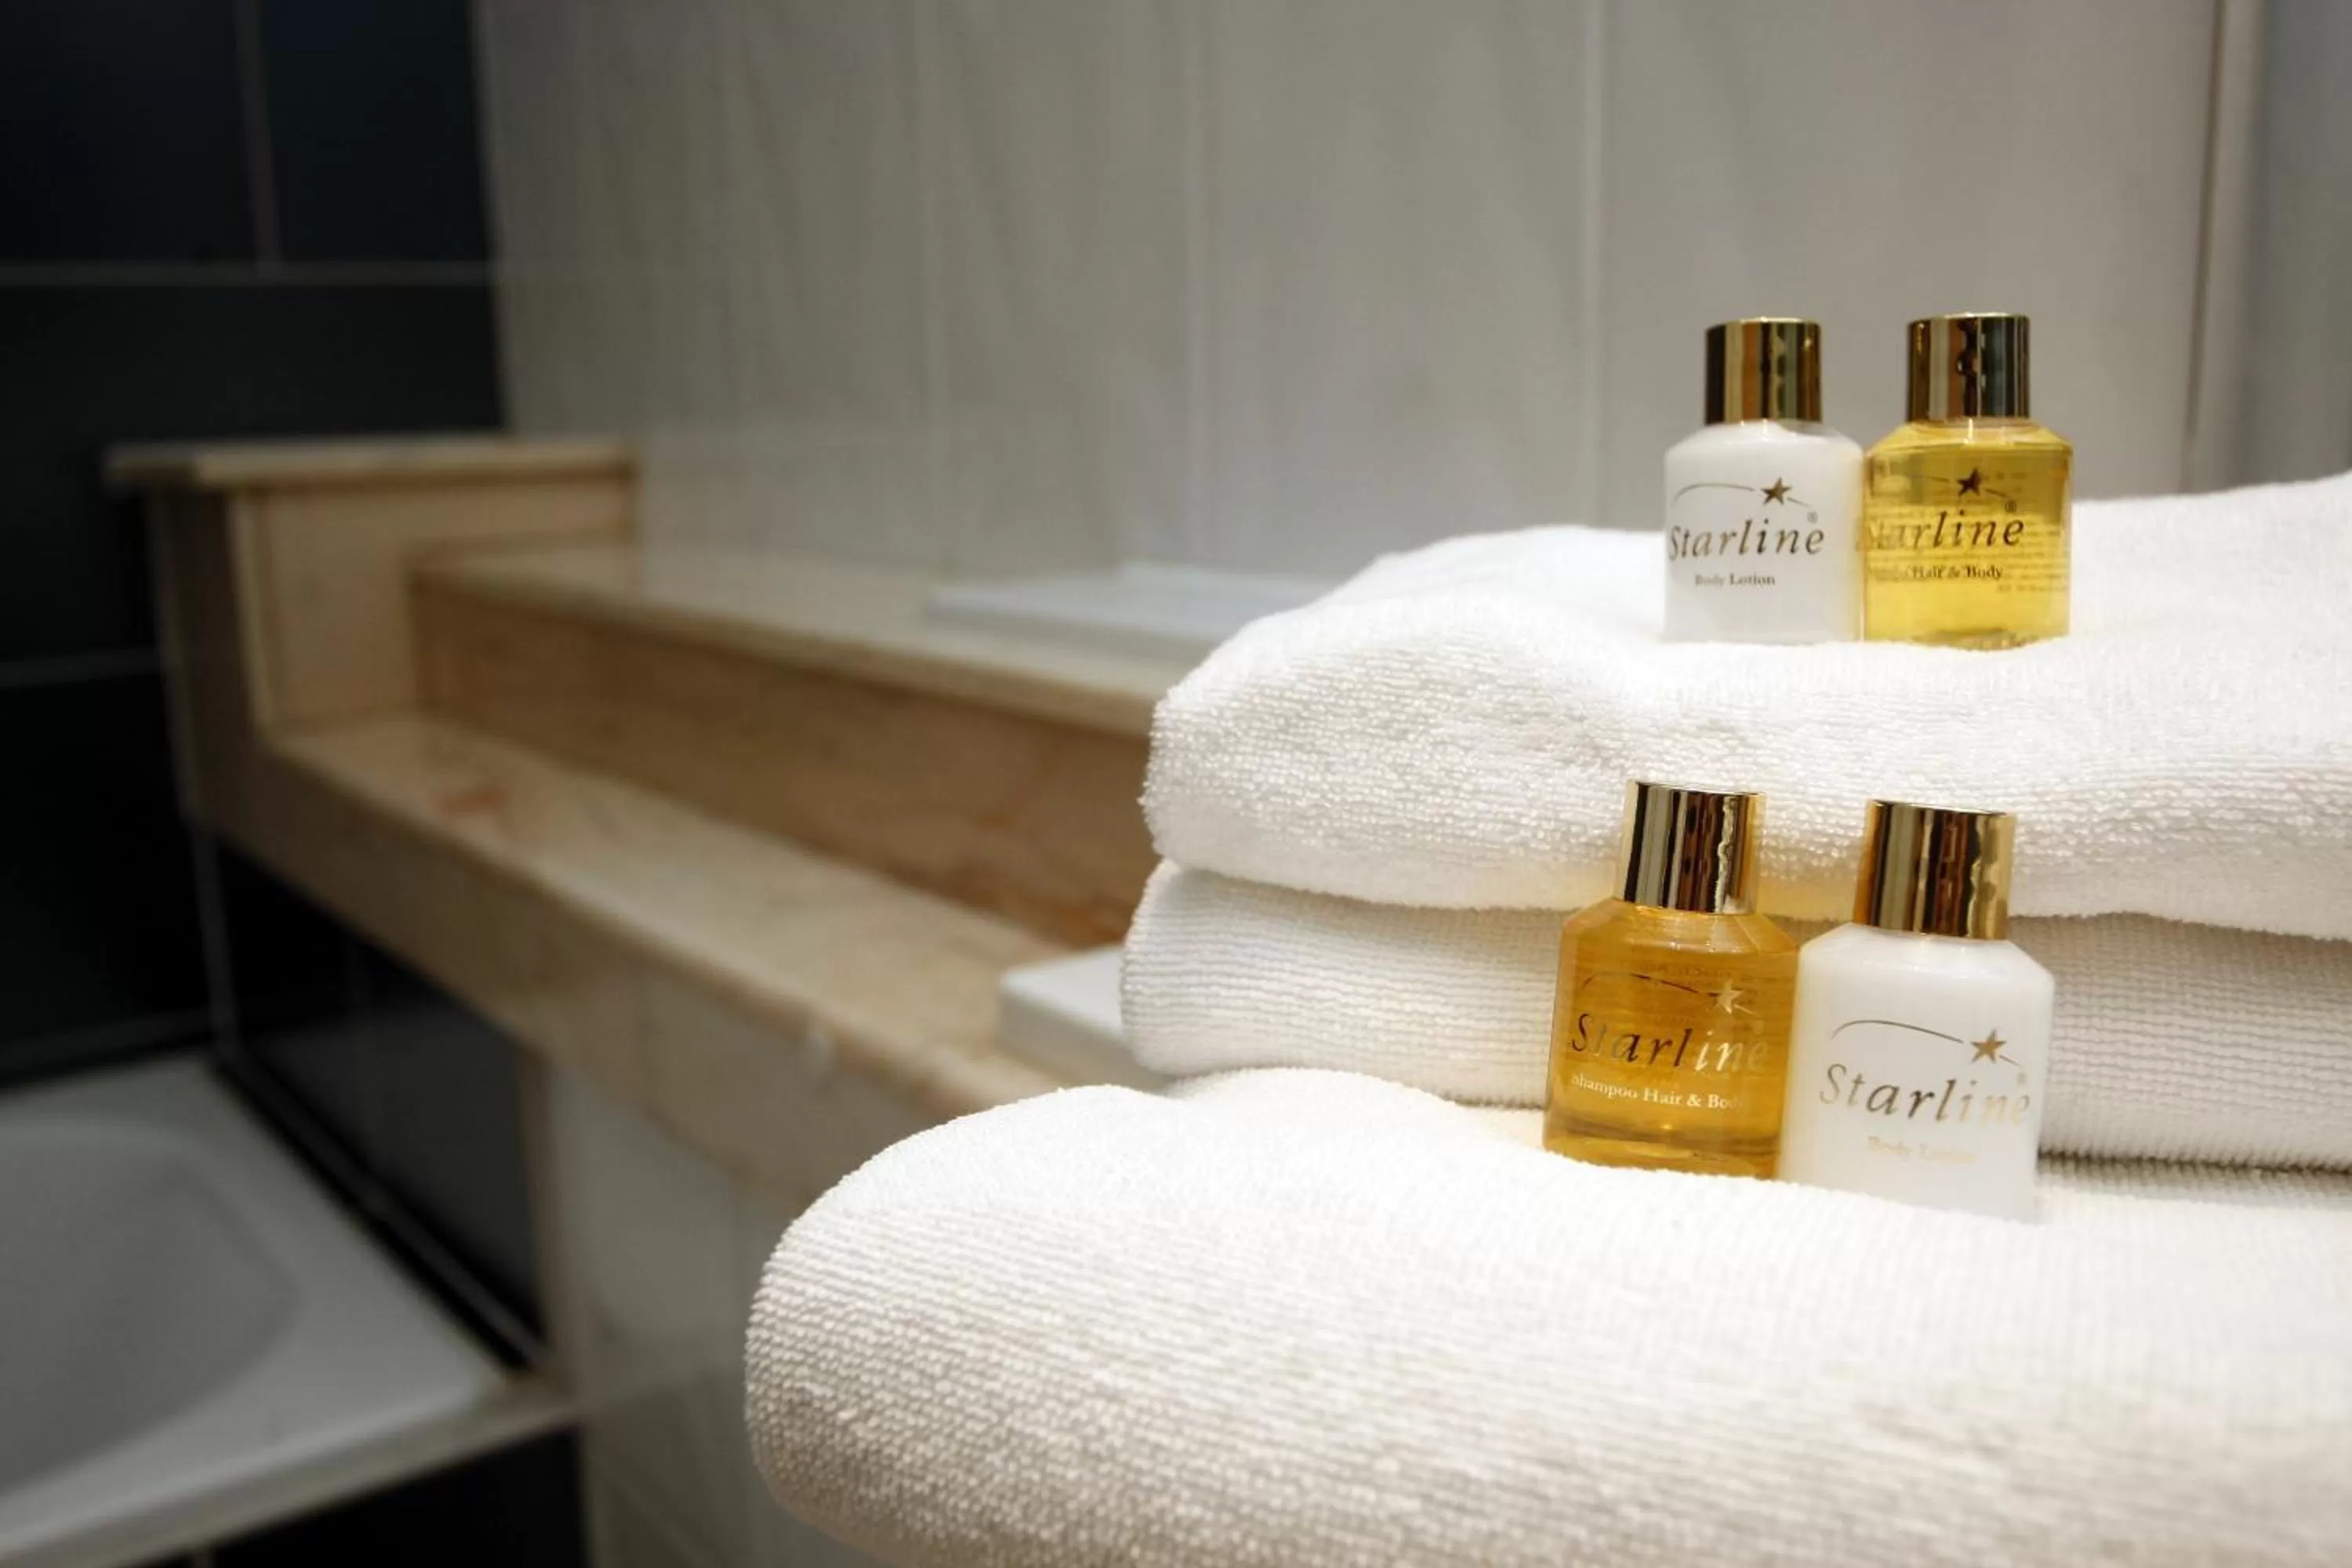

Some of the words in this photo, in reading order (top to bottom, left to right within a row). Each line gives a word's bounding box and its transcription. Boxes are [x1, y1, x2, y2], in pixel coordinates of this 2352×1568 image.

[1668, 517, 1825, 561] Starline
[1729, 572, 1776, 586] Lotion
[1965, 563, 2003, 579] Body
[1642, 1087, 1683, 1106] Hair
[1686, 1094, 1702, 1108] &
[1819, 1063, 2031, 1129] Starline
